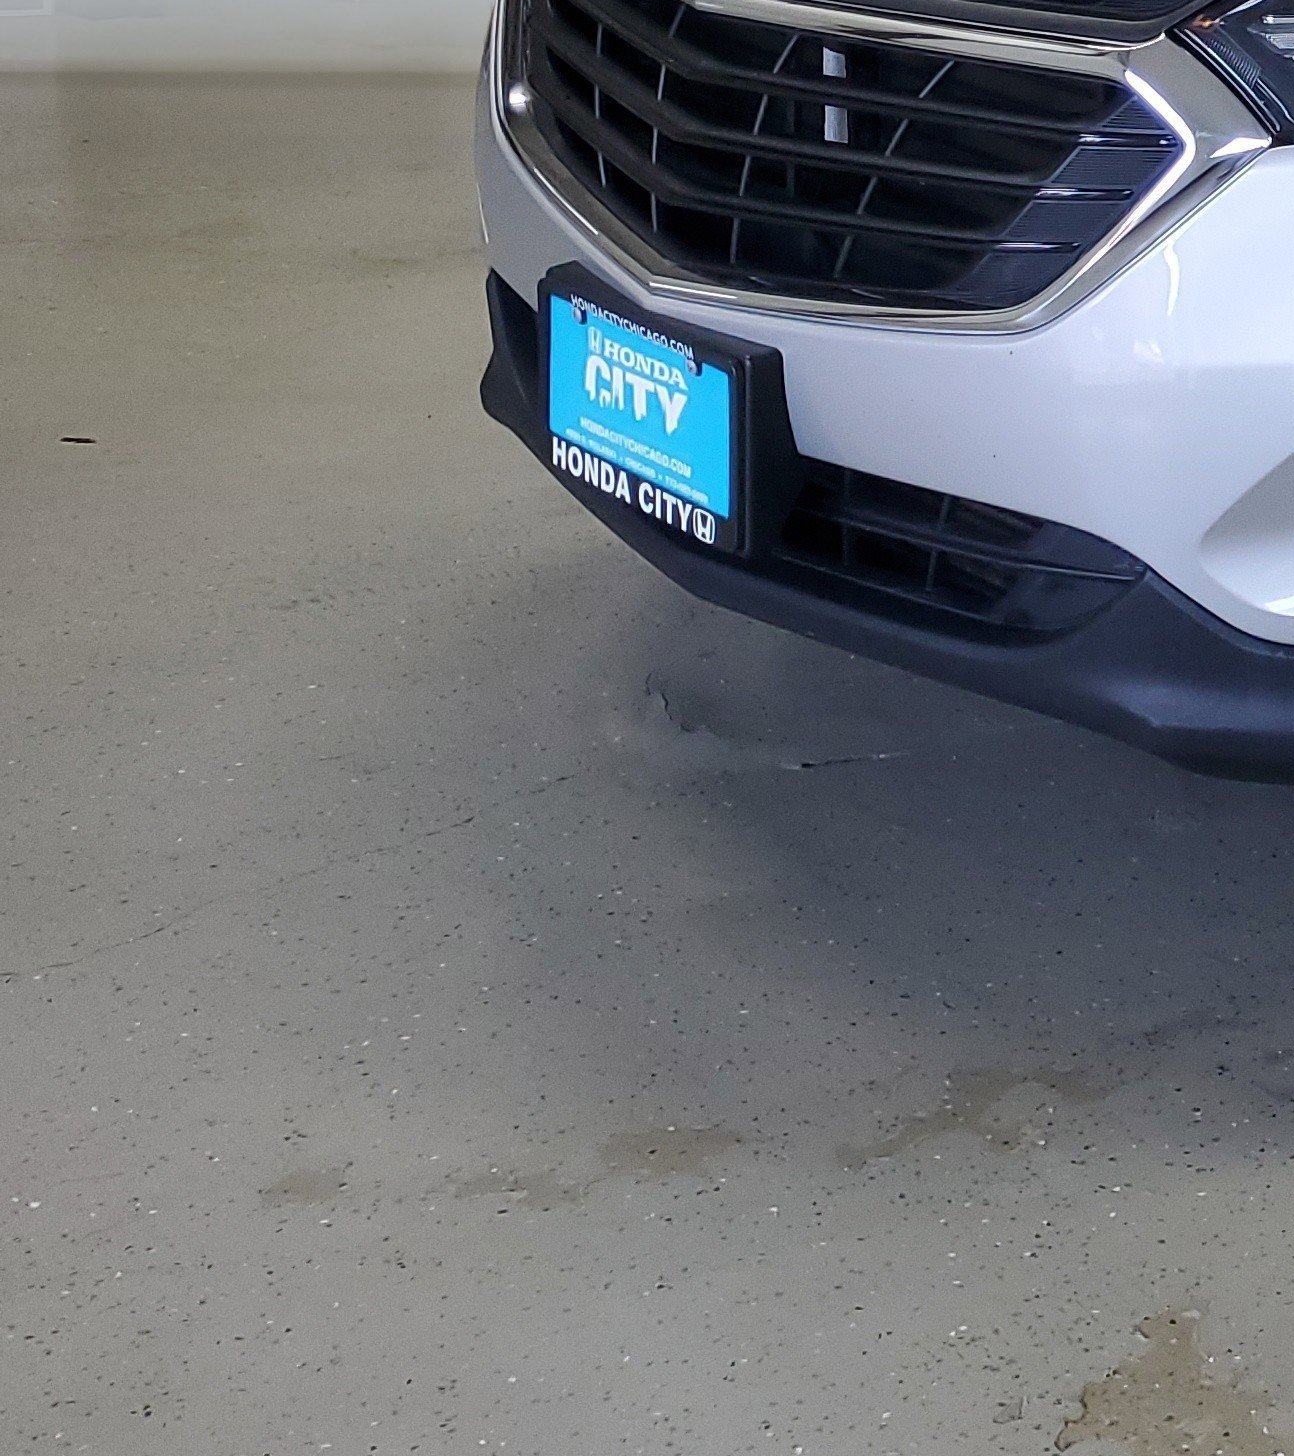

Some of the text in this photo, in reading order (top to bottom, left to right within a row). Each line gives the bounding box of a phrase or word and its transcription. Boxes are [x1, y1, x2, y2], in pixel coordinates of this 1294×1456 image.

[569, 293, 696, 361] HONDACITYCHICAGO.COM
[603, 337, 689, 392] HONDA
[584, 354, 689, 437] CITY
[552, 435, 632, 506] HONDA
[638, 481, 694, 533] CITY
